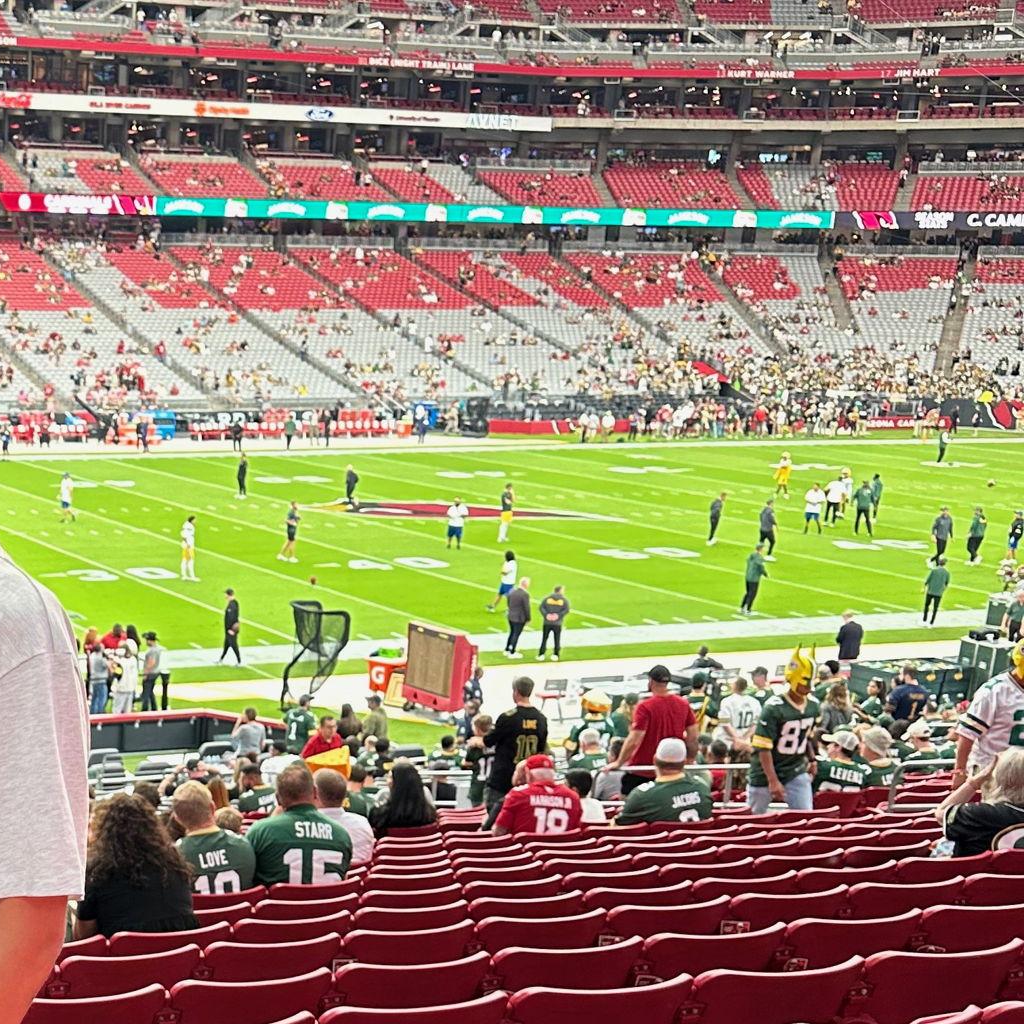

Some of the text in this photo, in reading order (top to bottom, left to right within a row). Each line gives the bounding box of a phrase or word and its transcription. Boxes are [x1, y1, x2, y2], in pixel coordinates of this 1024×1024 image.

[451, 61, 475, 71] LANE
[727, 70, 753, 78] KURT
[754, 71, 795, 79] WARNER
[894, 69, 912, 77] JIM
[913, 68, 941, 77] HART
[466, 113, 518, 131] AVNET
[370, 665, 386, 685] G
[738, 711, 753, 729] 10
[777, 717, 814, 755] 87
[830, 765, 864, 785] LEVENS
[294, 821, 334, 841] STARR
[198, 848, 229, 870] LOVE
[282, 848, 345, 885] 15
